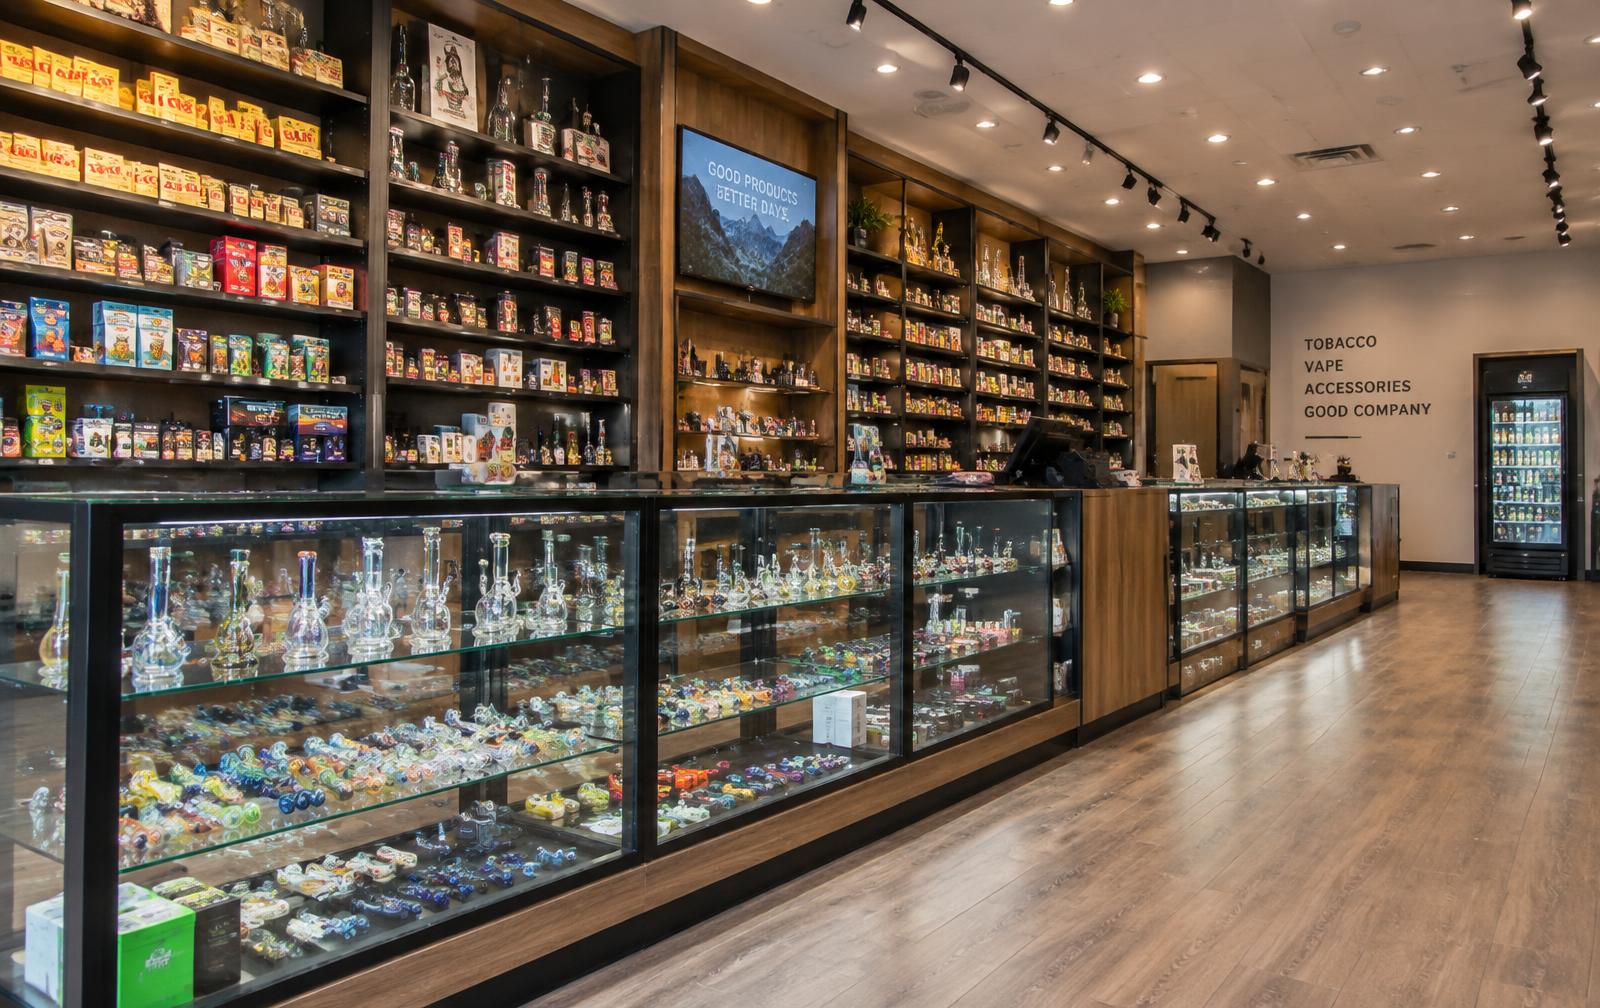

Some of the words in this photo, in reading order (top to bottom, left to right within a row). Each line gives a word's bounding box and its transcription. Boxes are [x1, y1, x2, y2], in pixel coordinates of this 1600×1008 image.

[708, 161, 740, 184] GOOD
[744, 174, 798, 205] PRODUCTS
[717, 184, 757, 211] BETTER
[1304, 335, 1377, 351] TOBACCO
[1304, 359, 1344, 373] VAPE
[1304, 380, 1411, 395] ACCESSORIES
[1304, 405, 1348, 418] GOOD
[1354, 403, 1432, 417] COMPANY
